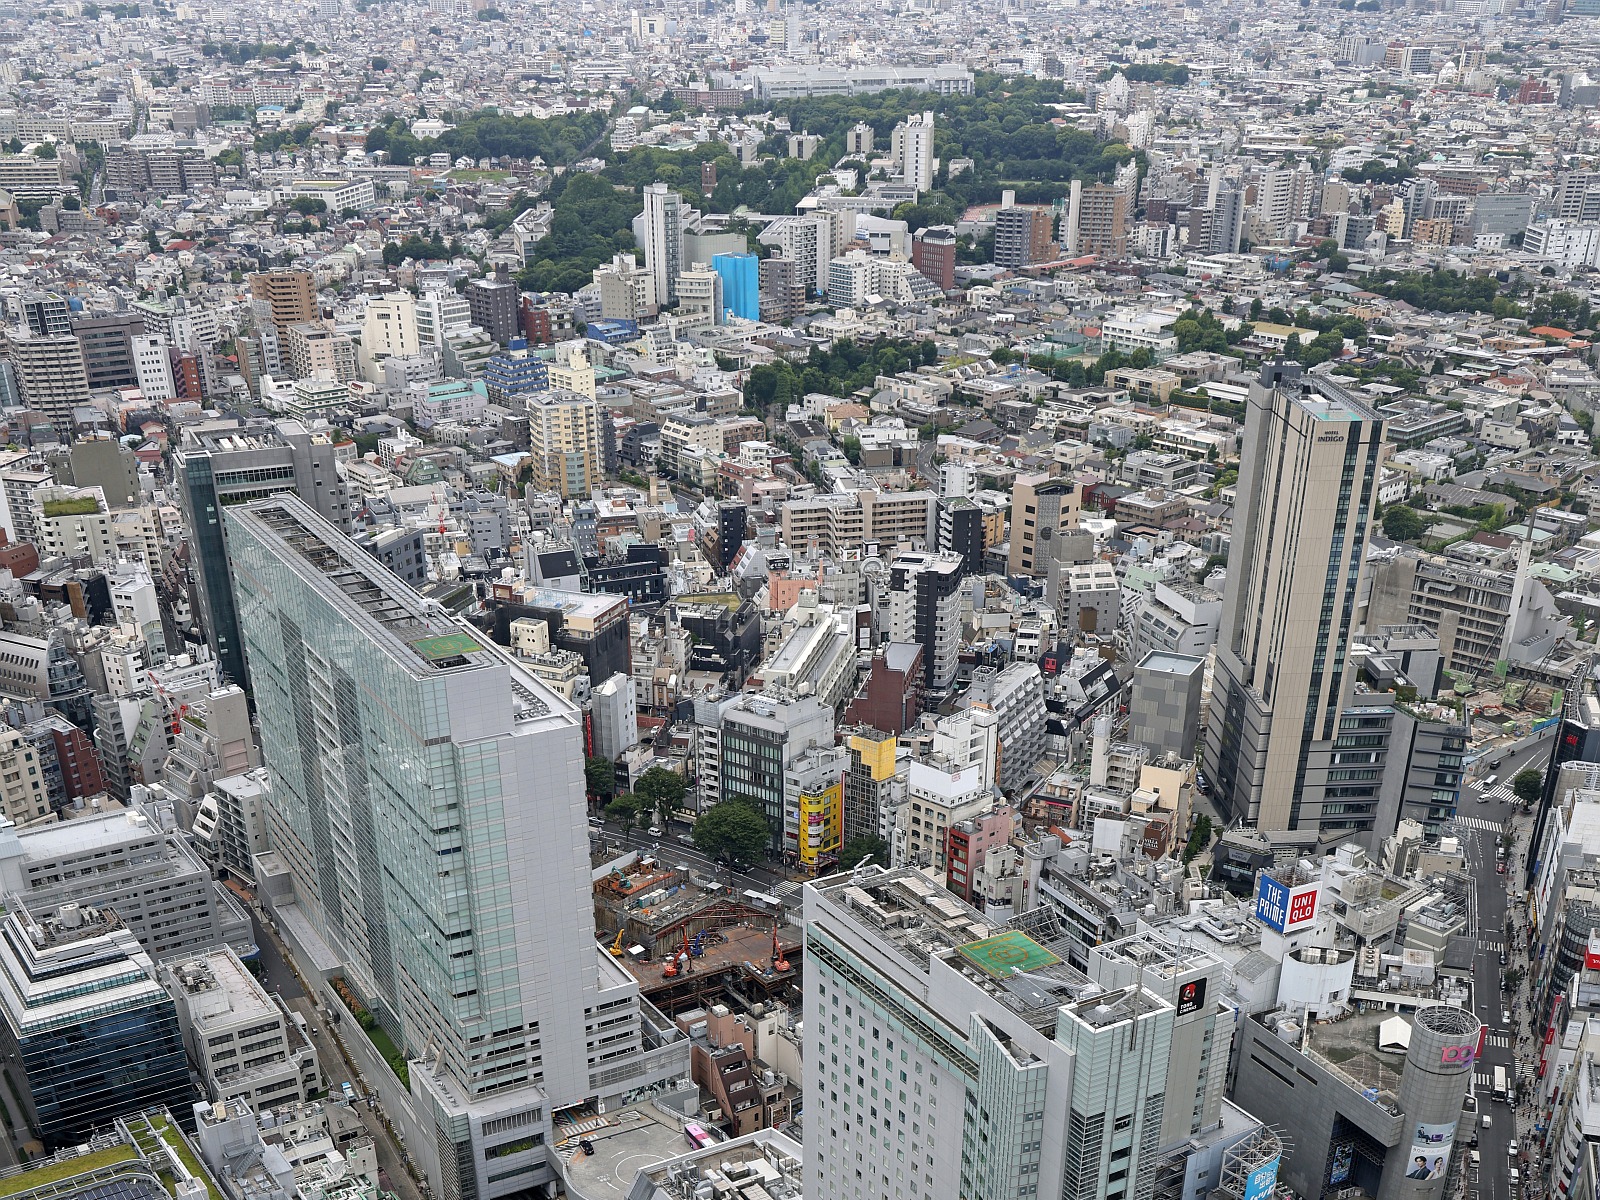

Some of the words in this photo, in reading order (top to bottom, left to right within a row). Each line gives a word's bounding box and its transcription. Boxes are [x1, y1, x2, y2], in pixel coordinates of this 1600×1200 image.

[1268, 883, 1283, 906] THE
[1294, 894, 1313, 908] UNI
[1259, 897, 1284, 926] PRIME
[1292, 906, 1312, 921] QLO
[1441, 1045, 1476, 1068] 109
